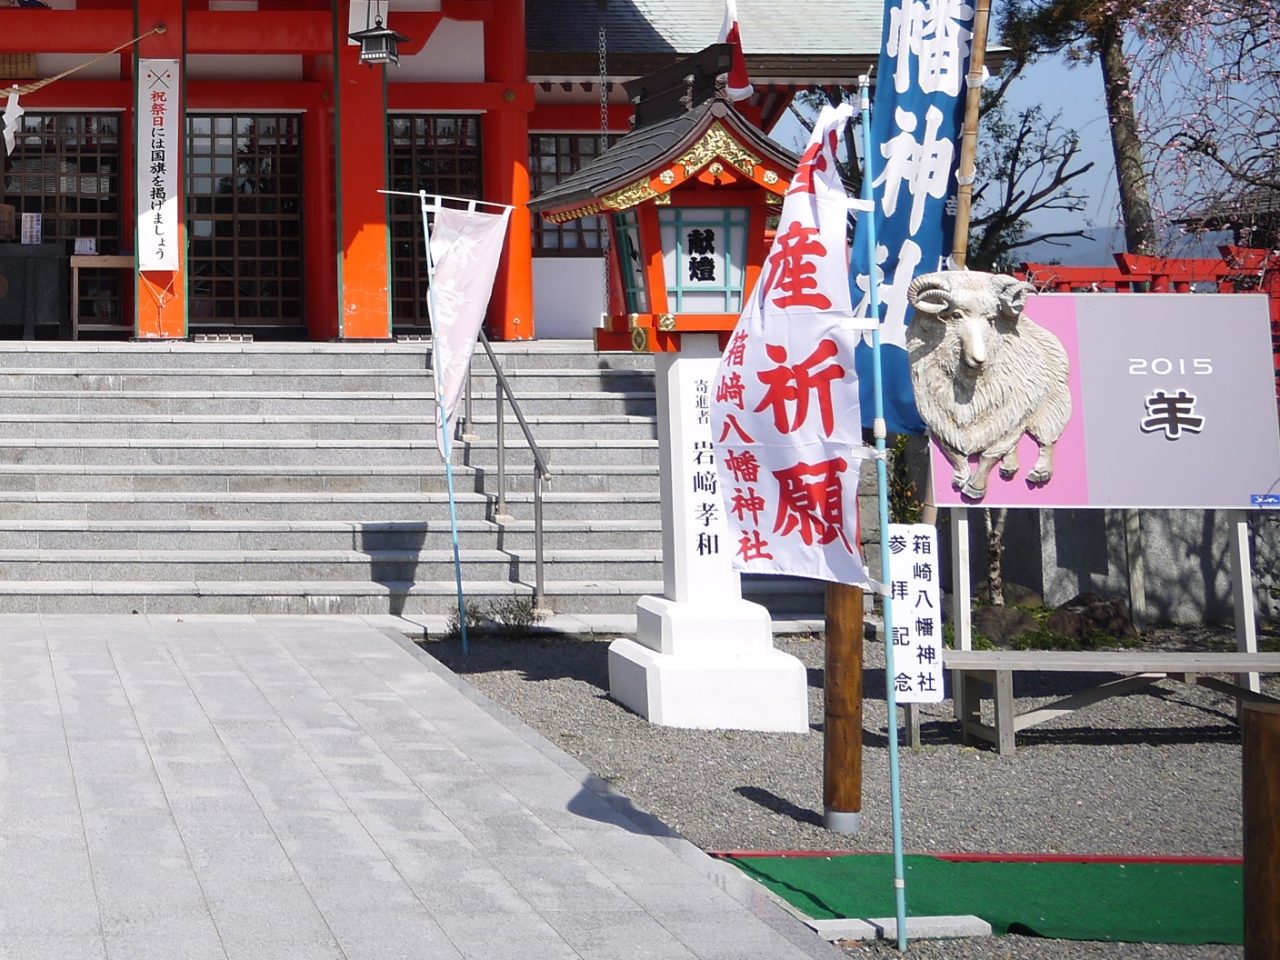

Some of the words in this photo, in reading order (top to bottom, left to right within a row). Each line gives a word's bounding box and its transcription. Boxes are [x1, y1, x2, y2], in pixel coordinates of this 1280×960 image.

[149, 90, 167, 260] 祝祭日には国旗を掲げましょう
[1129, 358, 1213, 375] 2015
[694, 379, 711, 424] 寄進者
[1141, 389, 1205, 440] 羊
